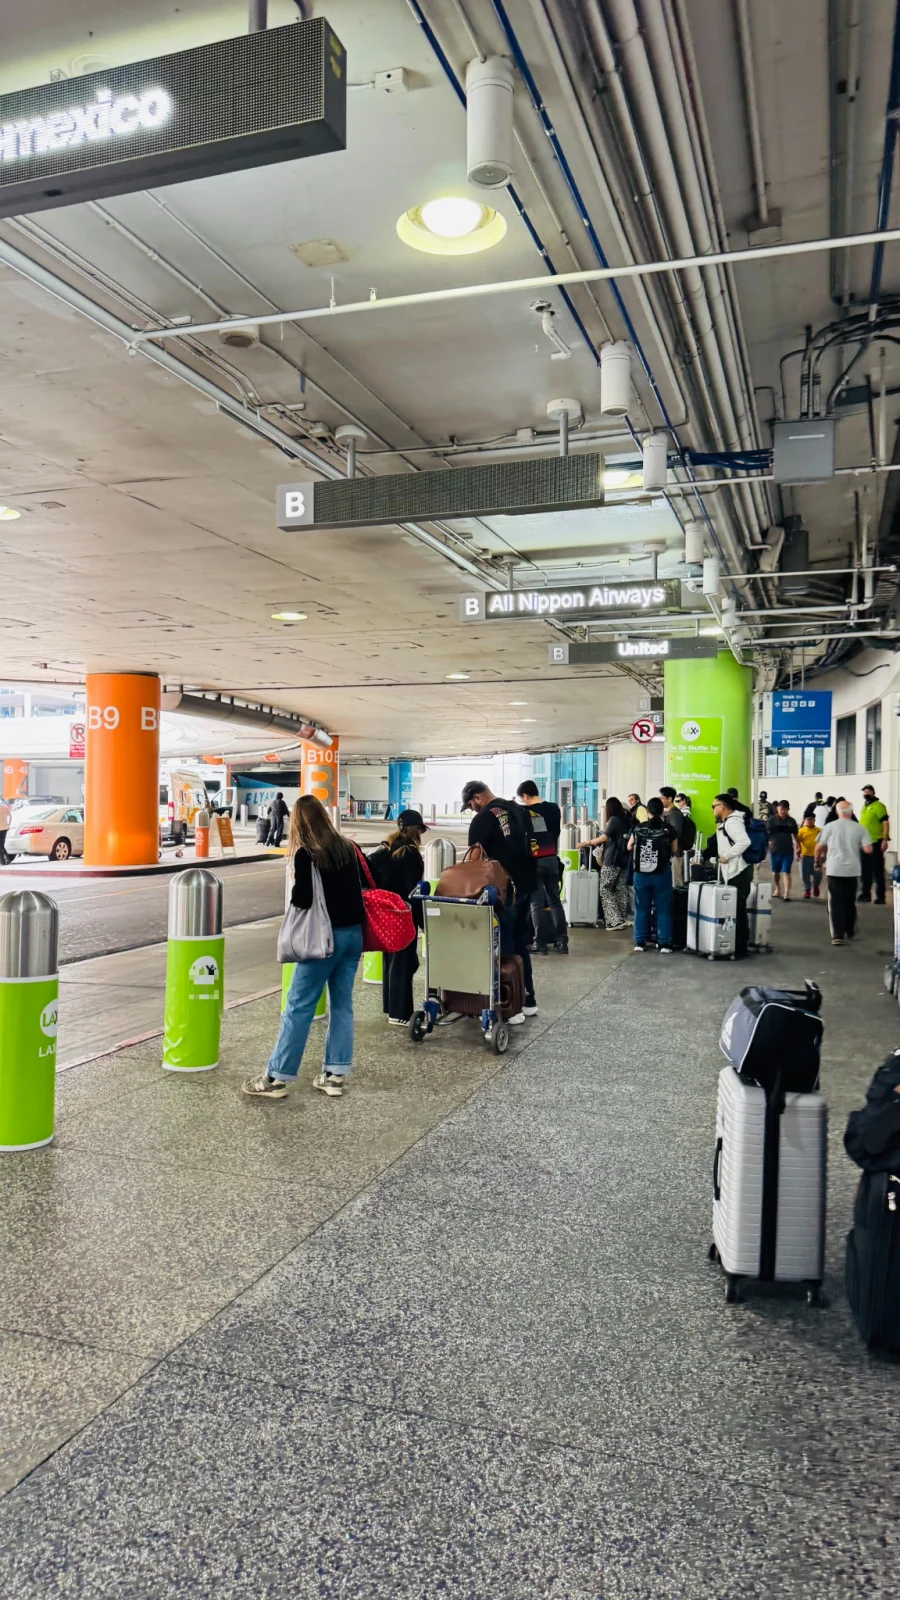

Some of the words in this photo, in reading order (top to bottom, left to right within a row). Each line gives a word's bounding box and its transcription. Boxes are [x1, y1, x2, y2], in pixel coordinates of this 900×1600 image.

[0, 87, 172, 160] mexico
[286, 491, 305, 518] B
[465, 598, 480, 616] B
[490, 594, 514, 612] All
[519, 592, 585, 613] Nippon
[589, 586, 665, 608] Airways
[553, 647, 564, 661] B
[618, 641, 669, 656] United
[641, 700, 648, 709] B
[88, 705, 120, 730] B9
[141, 706, 160, 731] B
[653, 715, 660, 723] B
[307, 749, 334, 763] B10
[304, 764, 334, 806] B
[244, 791, 276, 806] FLYAW
[645, 839, 653, 863] NORTH
